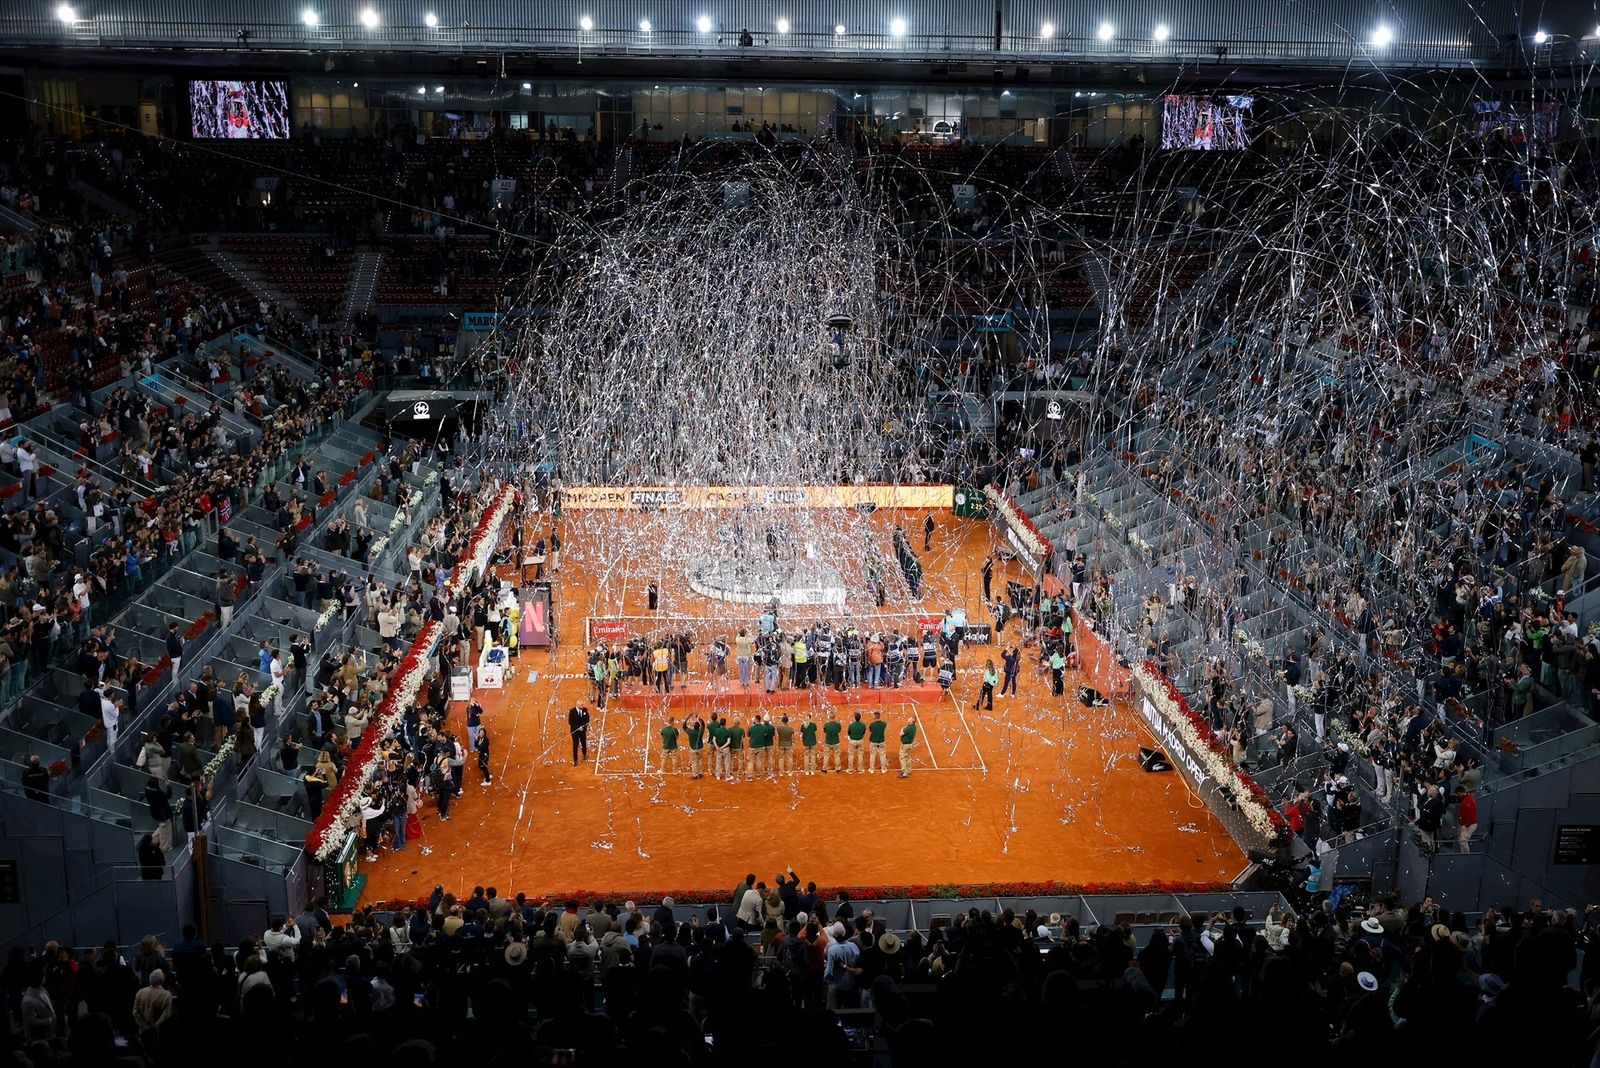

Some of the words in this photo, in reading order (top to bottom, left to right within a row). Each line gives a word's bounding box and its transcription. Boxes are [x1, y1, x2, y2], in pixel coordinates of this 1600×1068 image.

[593, 626, 625, 634] Emirates
[919, 622, 940, 630] Emira
[963, 632, 989, 645] Haier
[1186, 754, 1205, 784] OPEN
